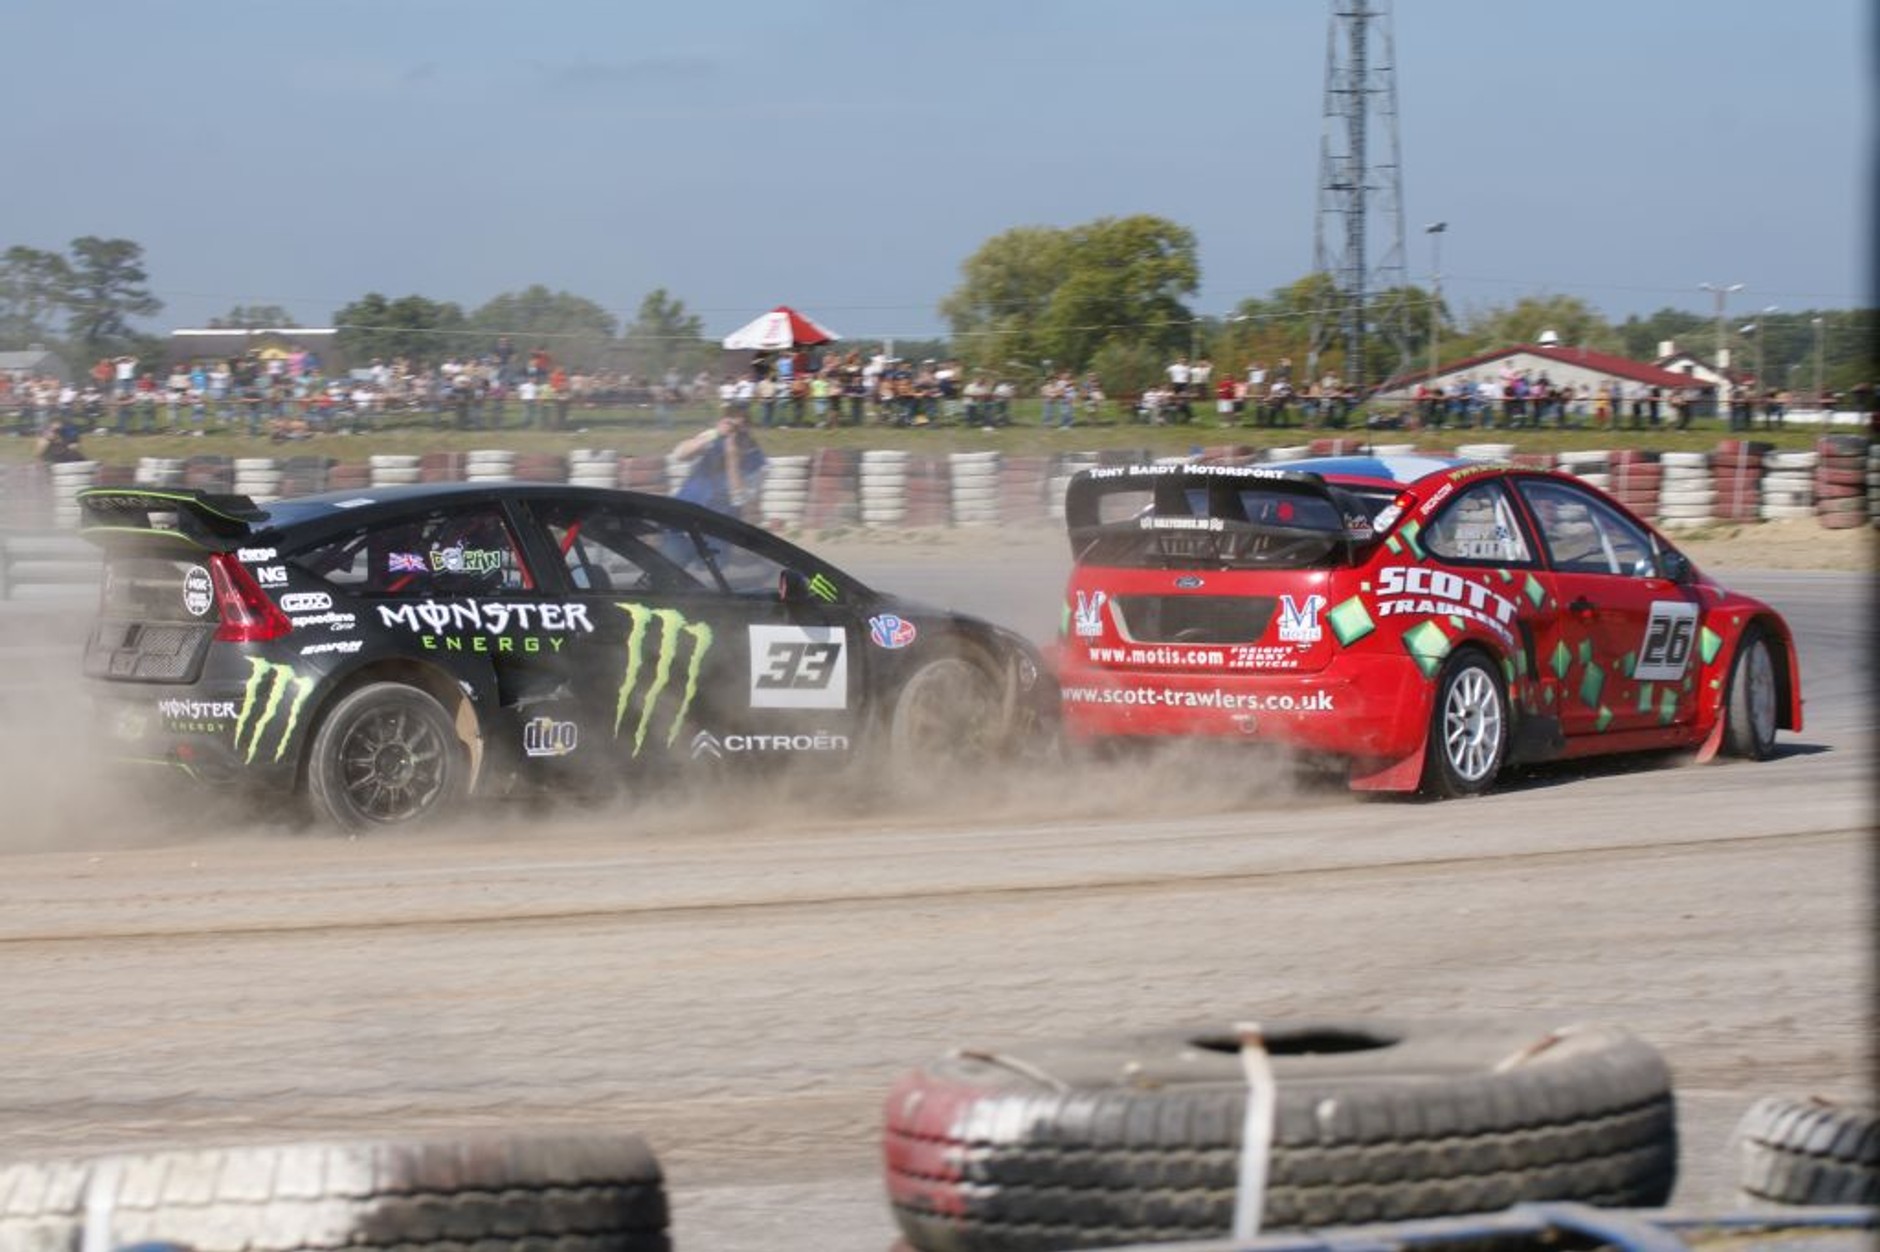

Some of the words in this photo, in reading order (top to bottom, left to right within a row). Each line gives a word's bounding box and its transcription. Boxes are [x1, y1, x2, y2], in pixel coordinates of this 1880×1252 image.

[1090, 466, 1125, 479] TONY
[1129, 465, 1178, 476] BARDY
[1183, 464, 1285, 480] MOTORSPORT
[256, 565, 289, 583] NG
[1375, 565, 1518, 625] SCOTT
[376, 597, 596, 636] MONSTER
[421, 635, 565, 652] ENERGY
[1641, 614, 1694, 667] 26
[755, 642, 842, 690] 33
[1089, 648, 1225, 666] www.motis.com
[158, 697, 241, 720] MONSTER
[1061, 687, 1335, 711] www.scott-trawlers.co.uk
